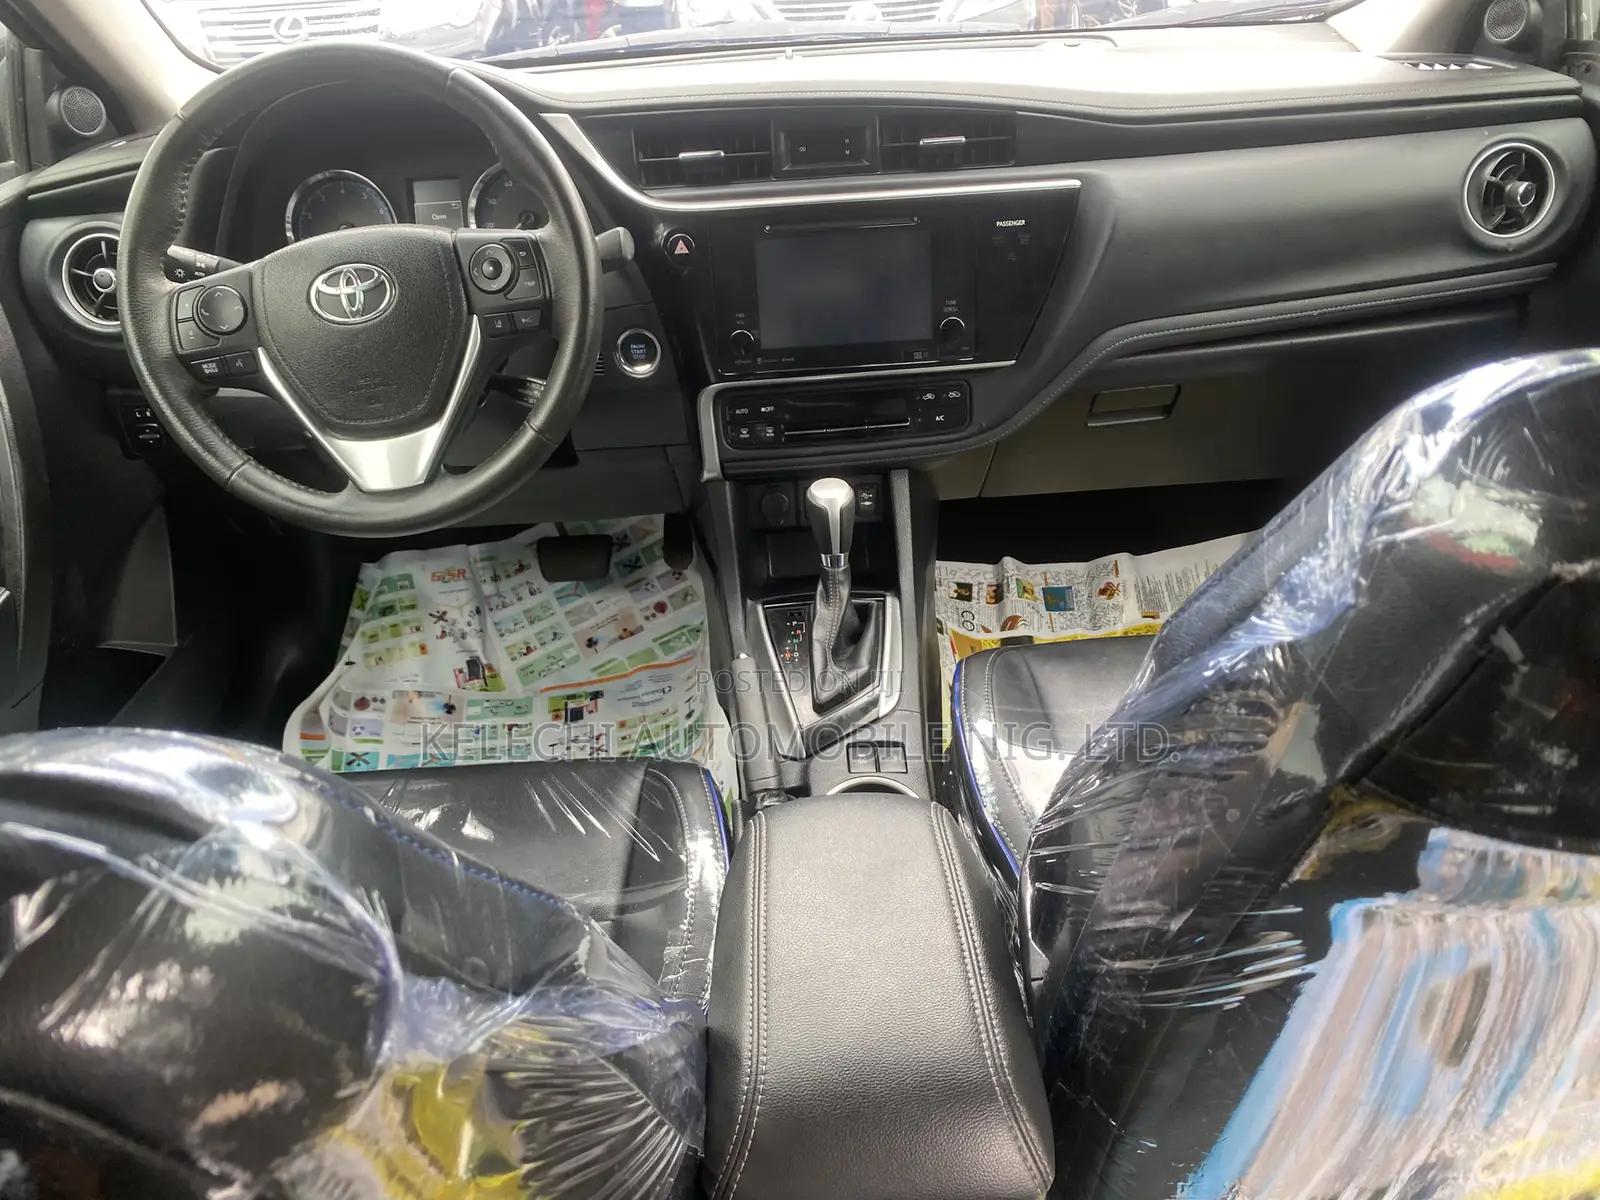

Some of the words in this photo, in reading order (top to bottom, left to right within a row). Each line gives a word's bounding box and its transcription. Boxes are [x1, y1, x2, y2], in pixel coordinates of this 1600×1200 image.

[431, 213, 447, 221] Open
[996, 219, 1026, 227] PASSENGER
[202, 361, 218, 370] MODE
